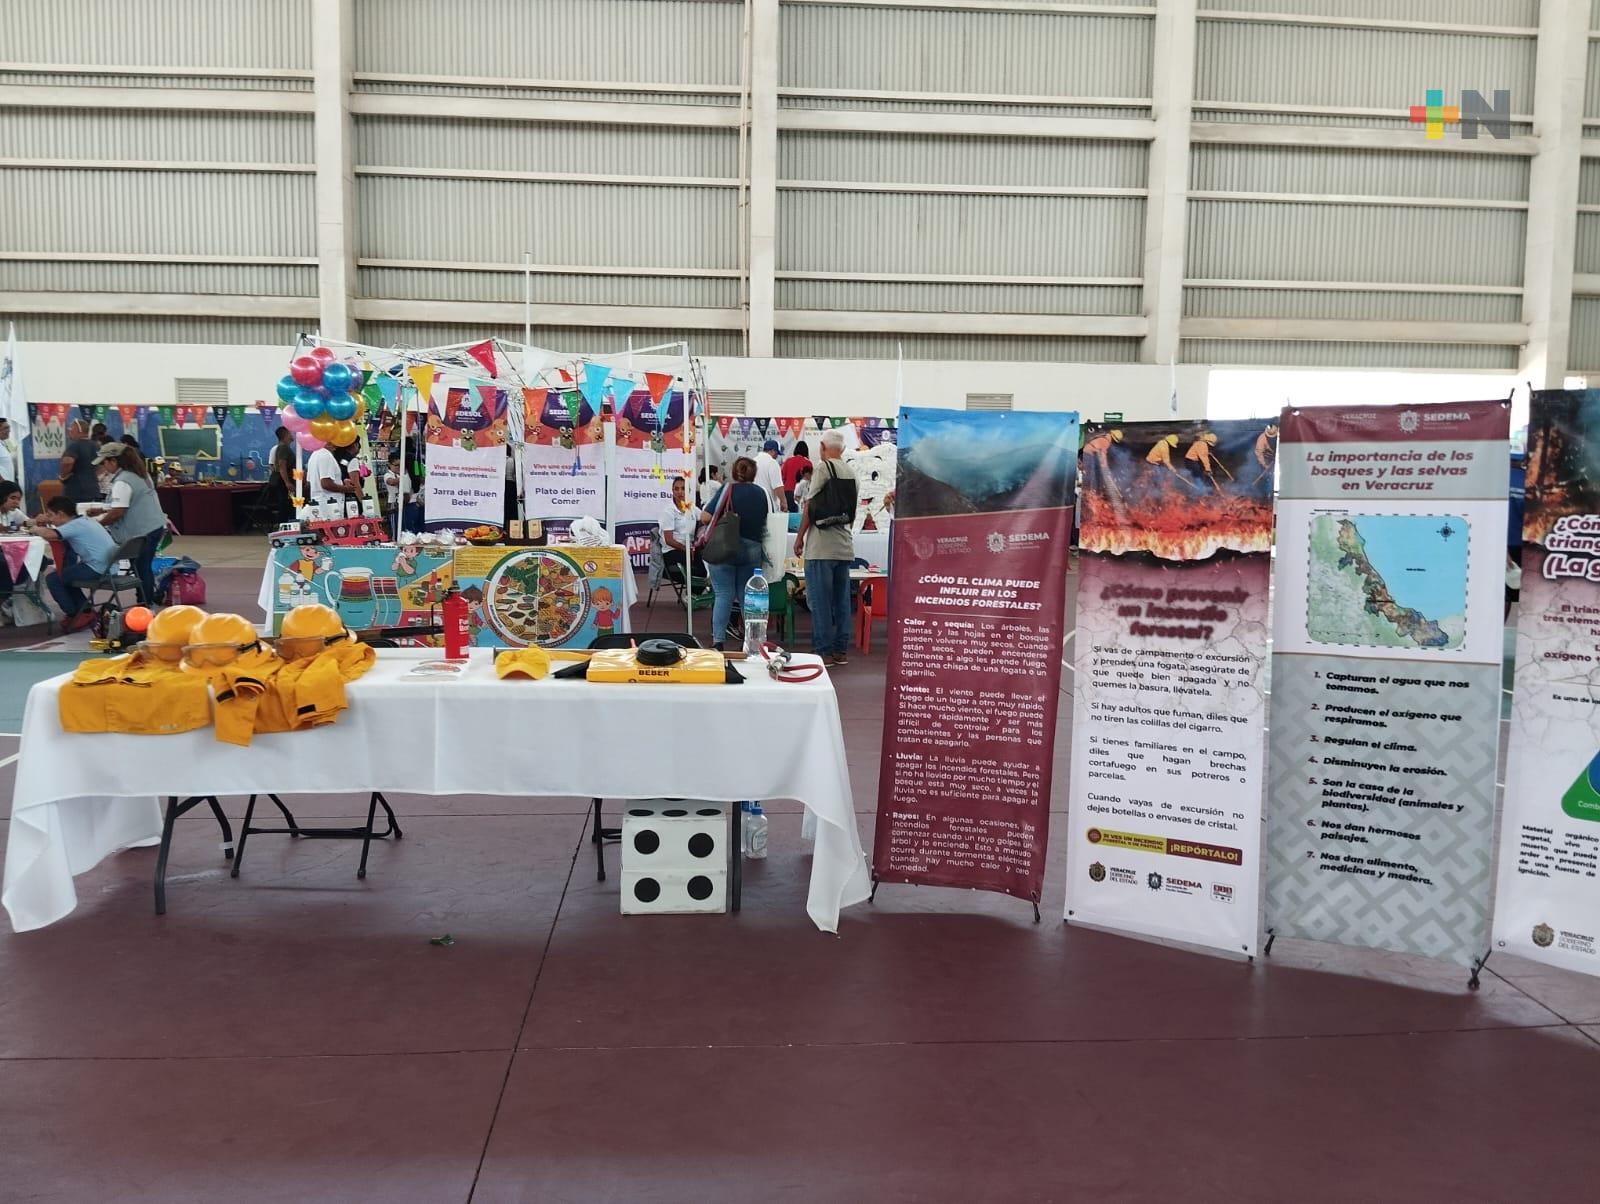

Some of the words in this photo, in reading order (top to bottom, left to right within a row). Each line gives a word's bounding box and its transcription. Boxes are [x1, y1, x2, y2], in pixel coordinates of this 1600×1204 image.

[1423, 413, 1470, 421] SEDEMA
[1306, 452, 1324, 461] La
[1328, 451, 1422, 463] importancia
[1427, 450, 1446, 460] de
[1450, 450, 1472, 460] los
[1311, 465, 1372, 478] bosques
[1378, 468, 1387, 477] y
[1390, 465, 1412, 475] las
[1418, 465, 1466, 475] selvas
[1365, 480, 1433, 489] Veracruz
[624, 491, 658, 500] Higiene
[1008, 532, 1050, 542] SEDEMA
[1547, 556, 1584, 575] (La
[918, 575, 954, 584] ¿CÓMO
[940, 587, 979, 595] INFLUIR
[915, 596, 969, 606] INCENDIOS
[972, 600, 1041, 610] FORESTALES?
[1001, 624, 1032, 632] árboles,
[1135, 650, 1194, 658] campamento
[1544, 651, 1591, 662] oxígeno
[1157, 662, 1189, 671] fogata,
[1190, 665, 1235, 674] asegúrate
[1178, 676, 1216, 684] apagada
[1326, 672, 1376, 682] Capturan
[1392, 678, 1420, 686] agua
[1138, 683, 1170, 693] basura,
[1173, 686, 1212, 695] llévatela.
[1326, 682, 1379, 693] tomamos.
[1325, 704, 1376, 714] Producen
[1391, 710, 1436, 720] oxígeno
[1324, 716, 1387, 727] respiramos.
[1324, 736, 1368, 746] Regulan
[1383, 742, 1417, 751] clima.
[896, 752, 922, 760] Lluvia:
[1323, 757, 1386, 770] Disminuyen
[1389, 763, 1400, 771] la
[1402, 767, 1447, 776] erosión.
[1345, 780, 1356, 788] la
[1386, 785, 1400, 793] de
[1402, 787, 1413, 795] la
[1322, 789, 1396, 803] biodiversidad
[1398, 798, 1453, 810] (animales
[1321, 800, 1369, 812] plantas).
[942, 815, 973, 823] algunas
[979, 820, 1019, 829] ocasiones,
[1321, 820, 1341, 829] Nos
[1344, 823, 1365, 832] dan
[1368, 826, 1420, 839] hermosos
[1320, 832, 1368, 843] paisajes.
[1171, 844, 1237, 861] ¡REPÓRTALO!
[1320, 852, 1340, 861] Nos
[1343, 854, 1363, 864] dan
[1366, 858, 1418, 872] alimento,
[1320, 863, 1375, 876] medicinas
[1387, 873, 1432, 884] madera.
[1166, 877, 1202, 889] SEDEMA
